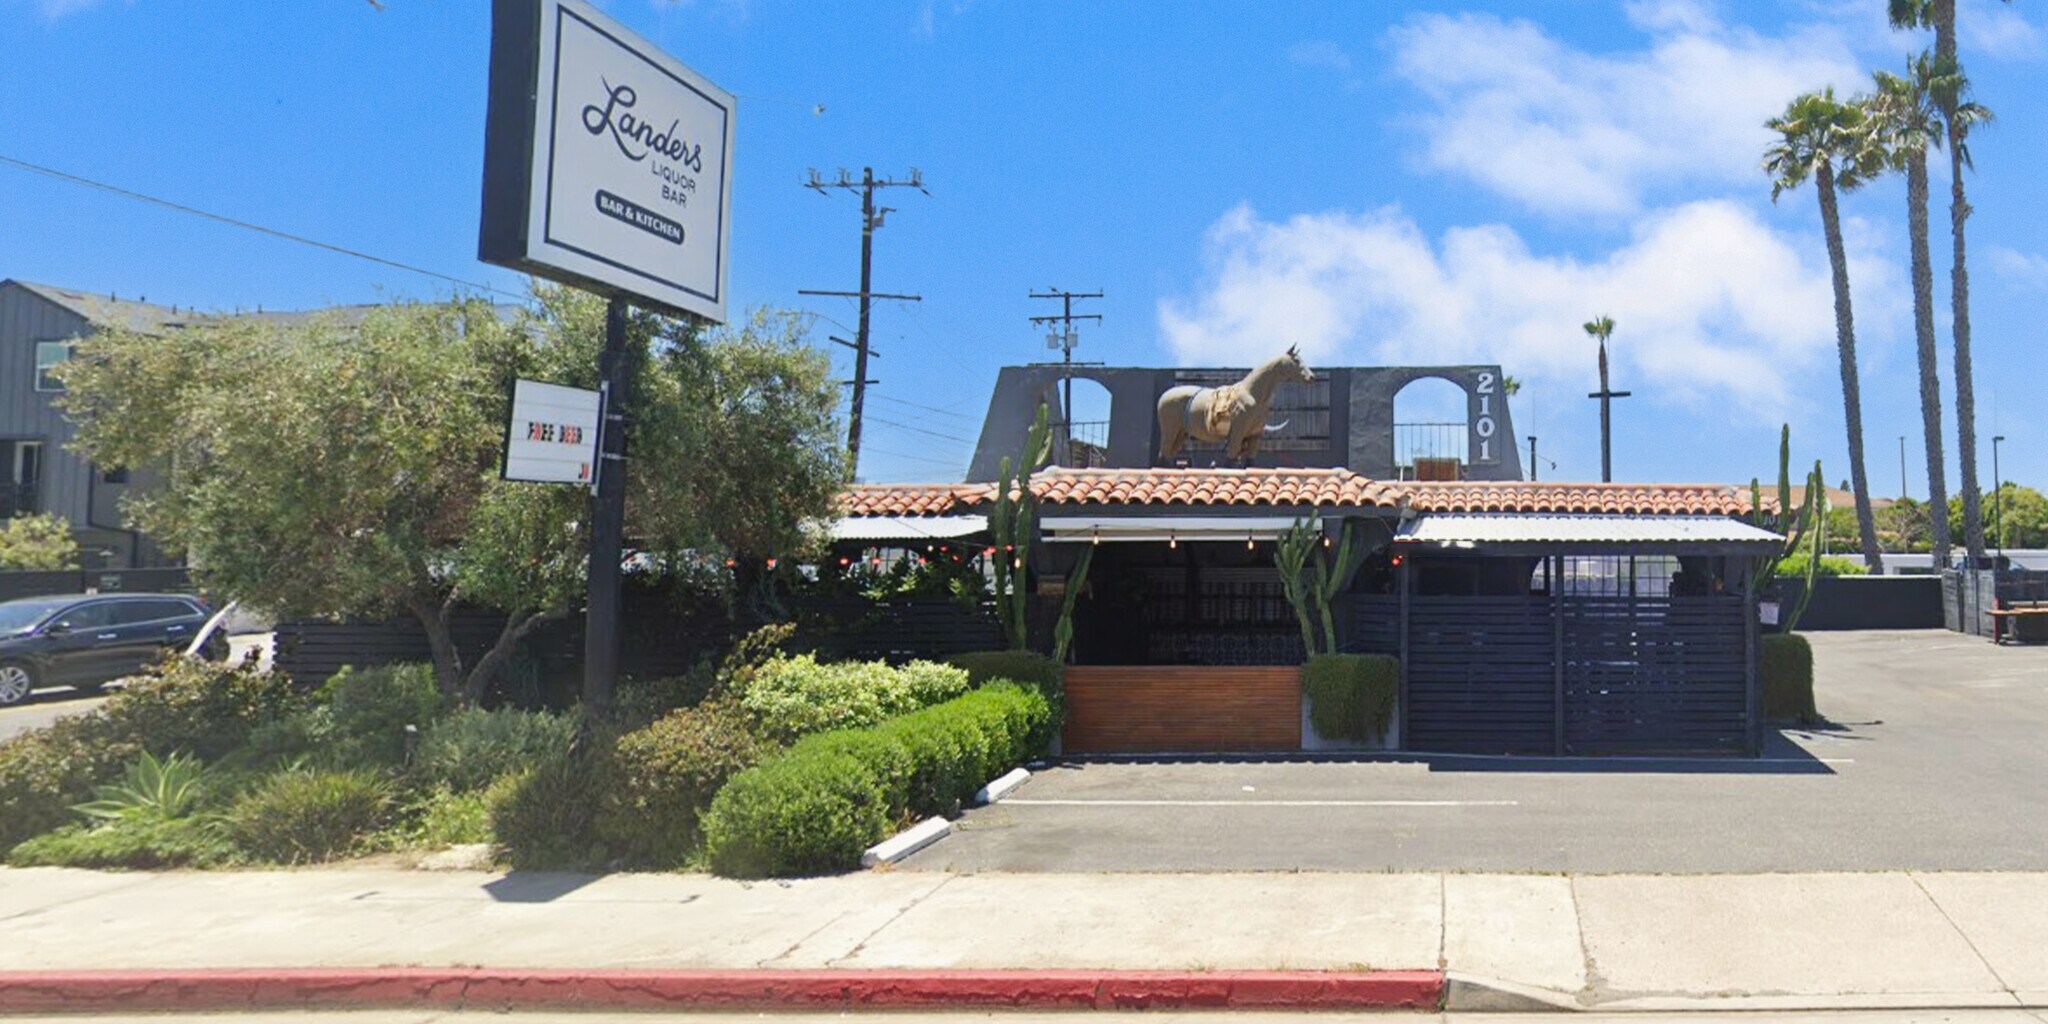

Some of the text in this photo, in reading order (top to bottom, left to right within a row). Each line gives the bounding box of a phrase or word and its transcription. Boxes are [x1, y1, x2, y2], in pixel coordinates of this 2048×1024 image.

[582, 74, 703, 174] Landers
[652, 160, 696, 194] LIQUOR
[600, 195, 681, 239] BAR & KITCHEN
[661, 187, 688, 208] BAR
[527, 422, 554, 441] FREE
[1476, 372, 1495, 460] 2101
